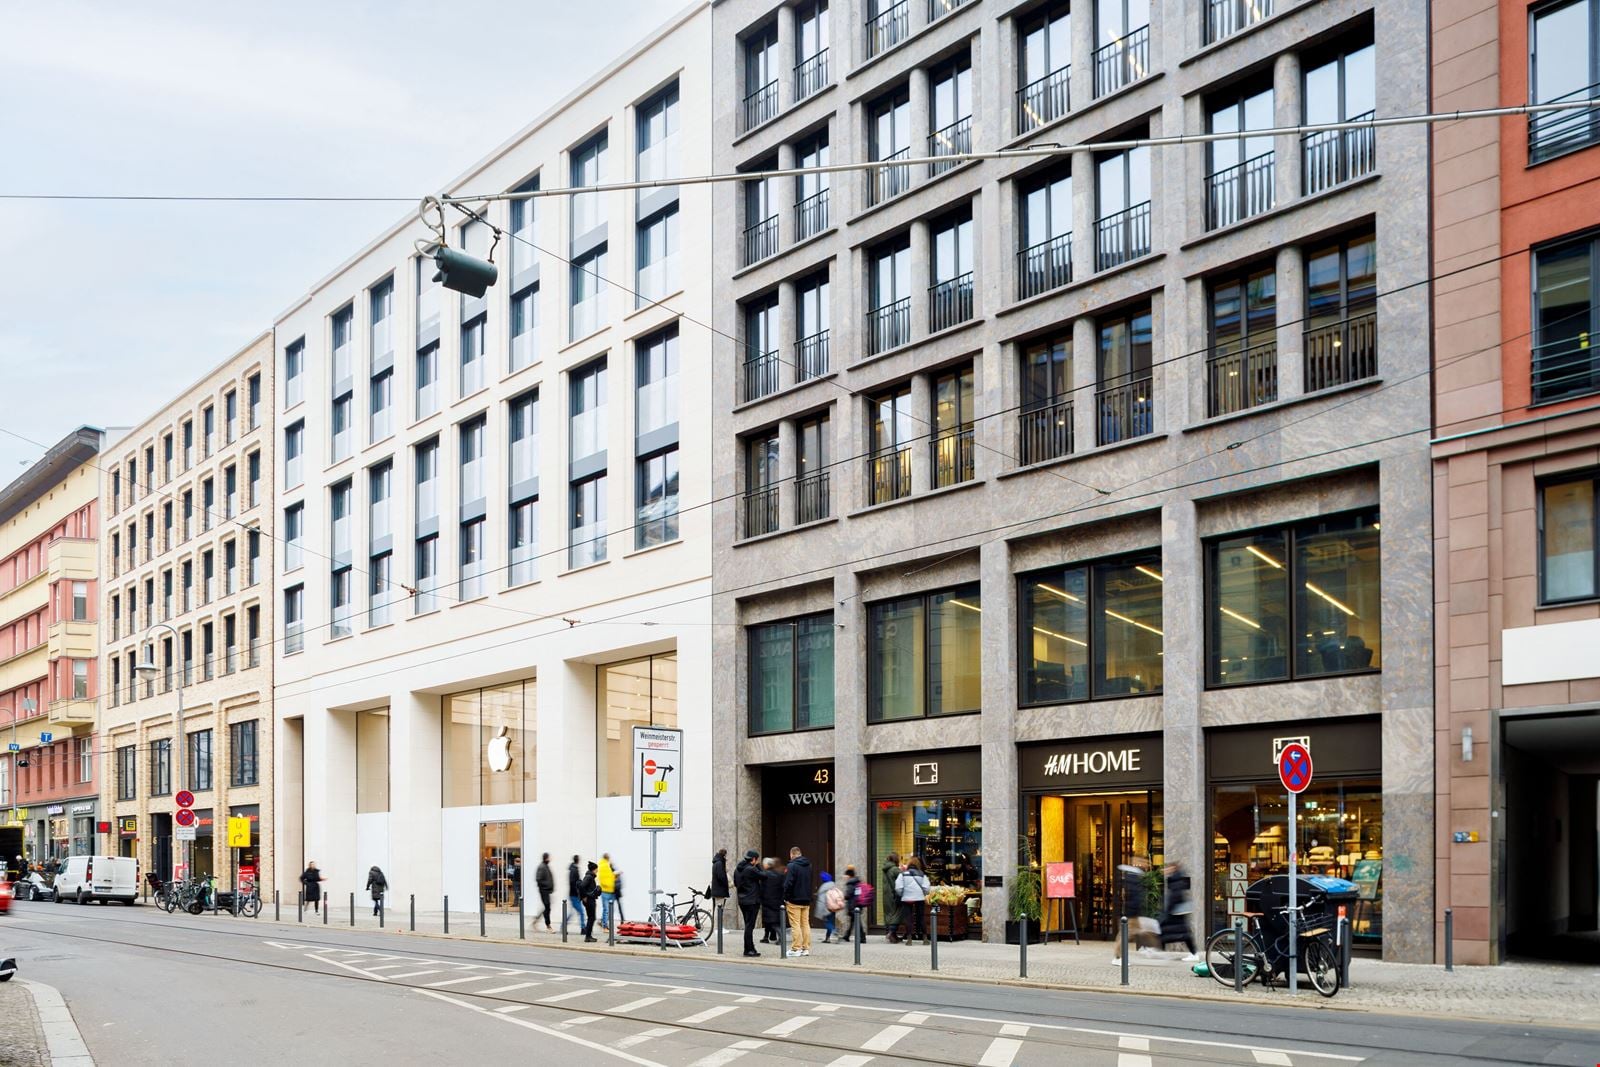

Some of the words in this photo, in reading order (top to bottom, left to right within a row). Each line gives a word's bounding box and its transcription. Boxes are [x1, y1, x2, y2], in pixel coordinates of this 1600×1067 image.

[44, 733, 50, 741] T
[1044, 753, 1072, 776] H&M
[1073, 749, 1141, 774] HOME
[814, 769, 829, 784] 43
[658, 782, 664, 791] U
[643, 815, 671, 824] Umleitung
[235, 821, 242, 829] U
[1049, 873, 1072, 884] SALE
[1233, 863, 1247, 929] SAL
